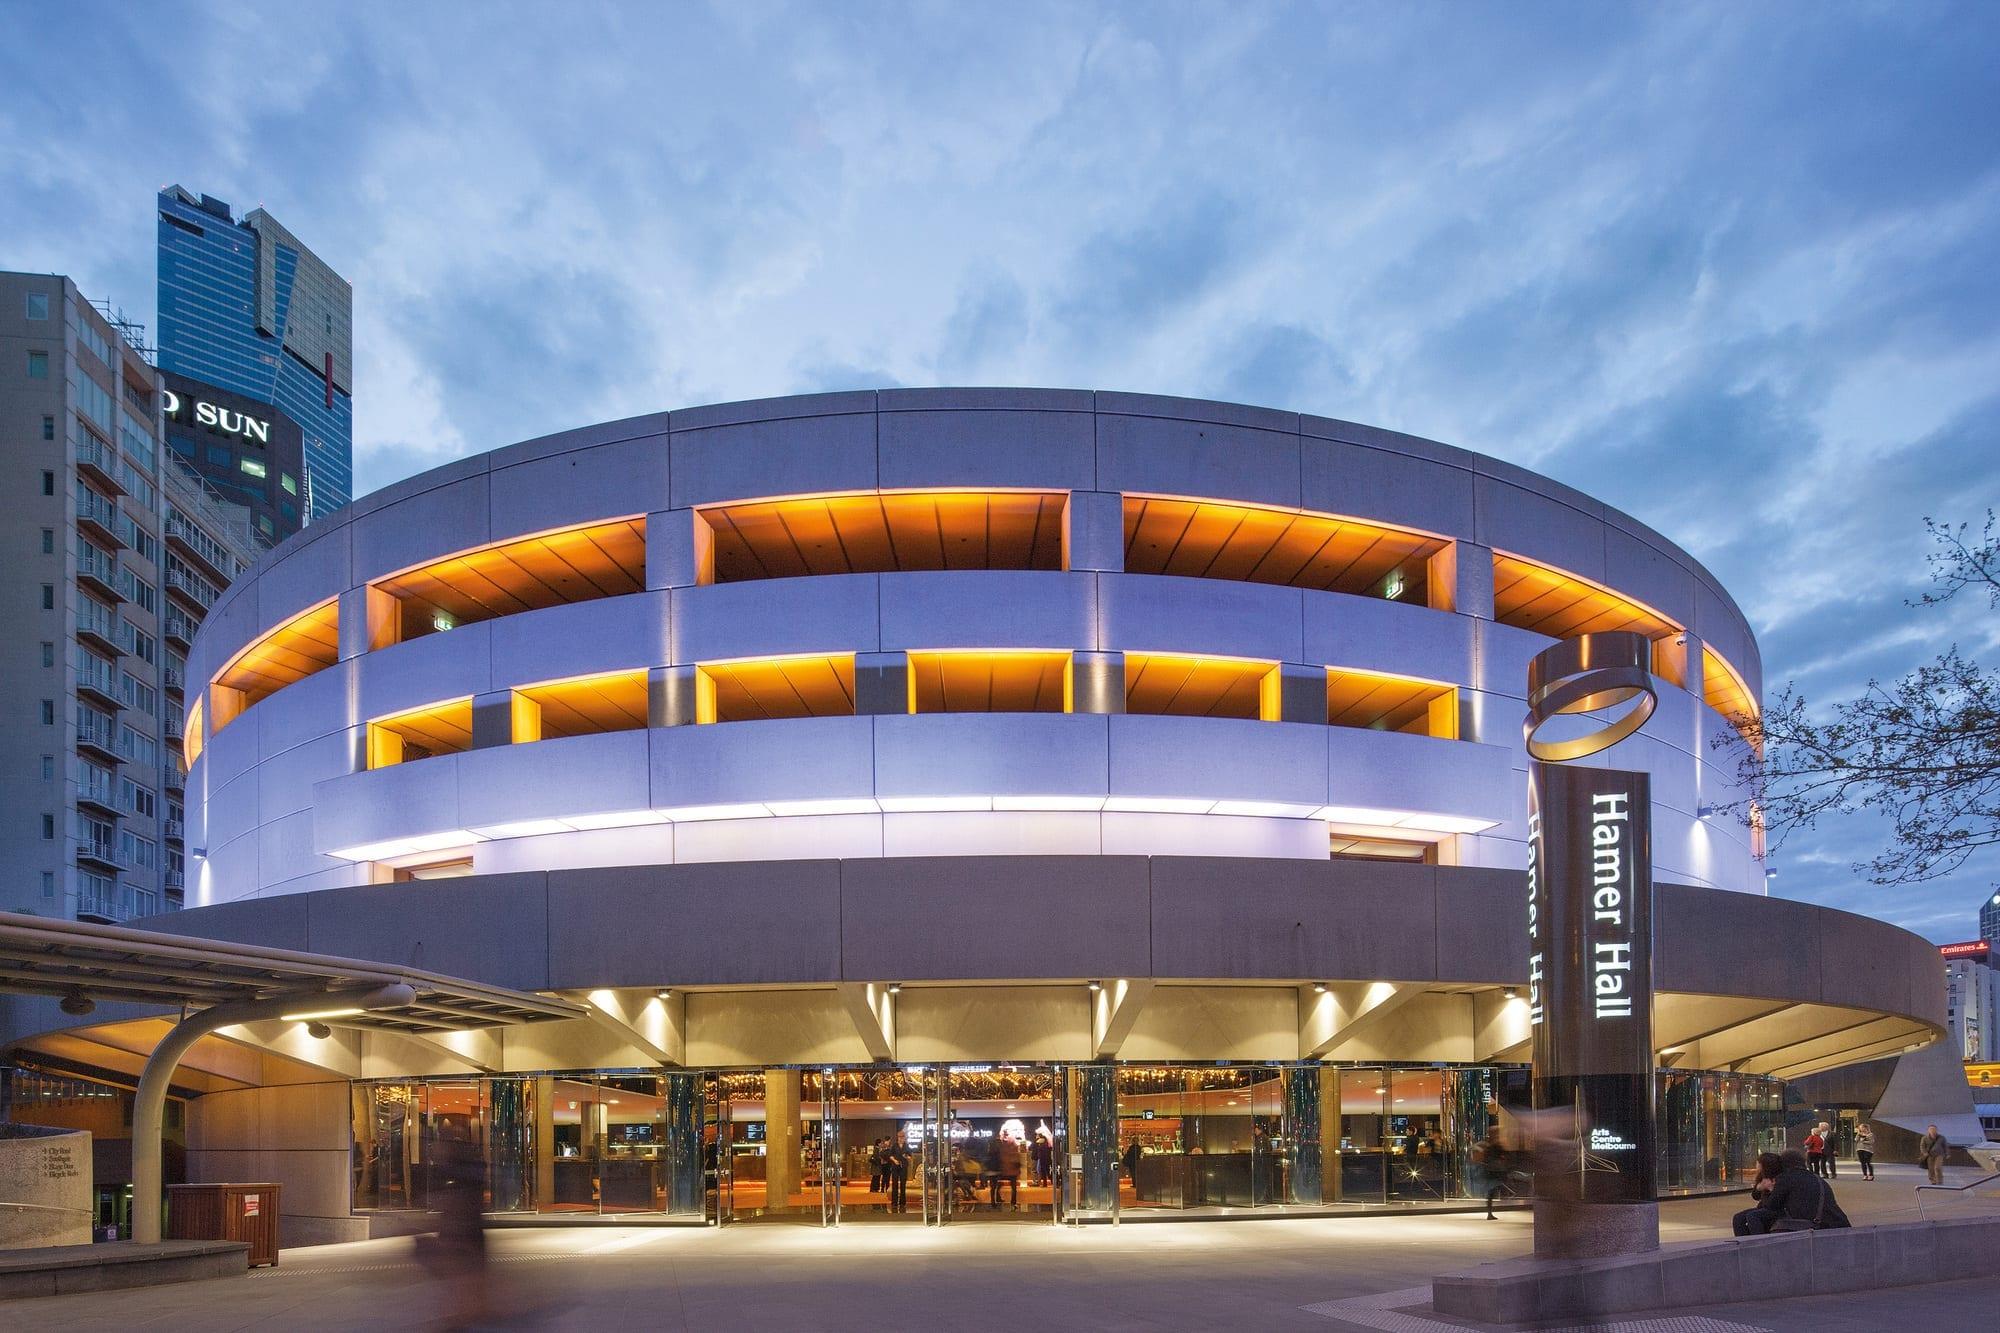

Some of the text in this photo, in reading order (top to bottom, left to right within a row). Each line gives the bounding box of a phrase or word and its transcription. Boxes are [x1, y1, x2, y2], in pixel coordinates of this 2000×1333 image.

[196, 402, 270, 443] SUN
[1528, 811, 1543, 1025] Hamer Hall
[1592, 792, 1632, 1019] Hamer Hall
[1940, 944, 1976, 954] Emirates
[1591, 1128, 1610, 1136] Arts
[1591, 1142, 1636, 1150] Melbourne
